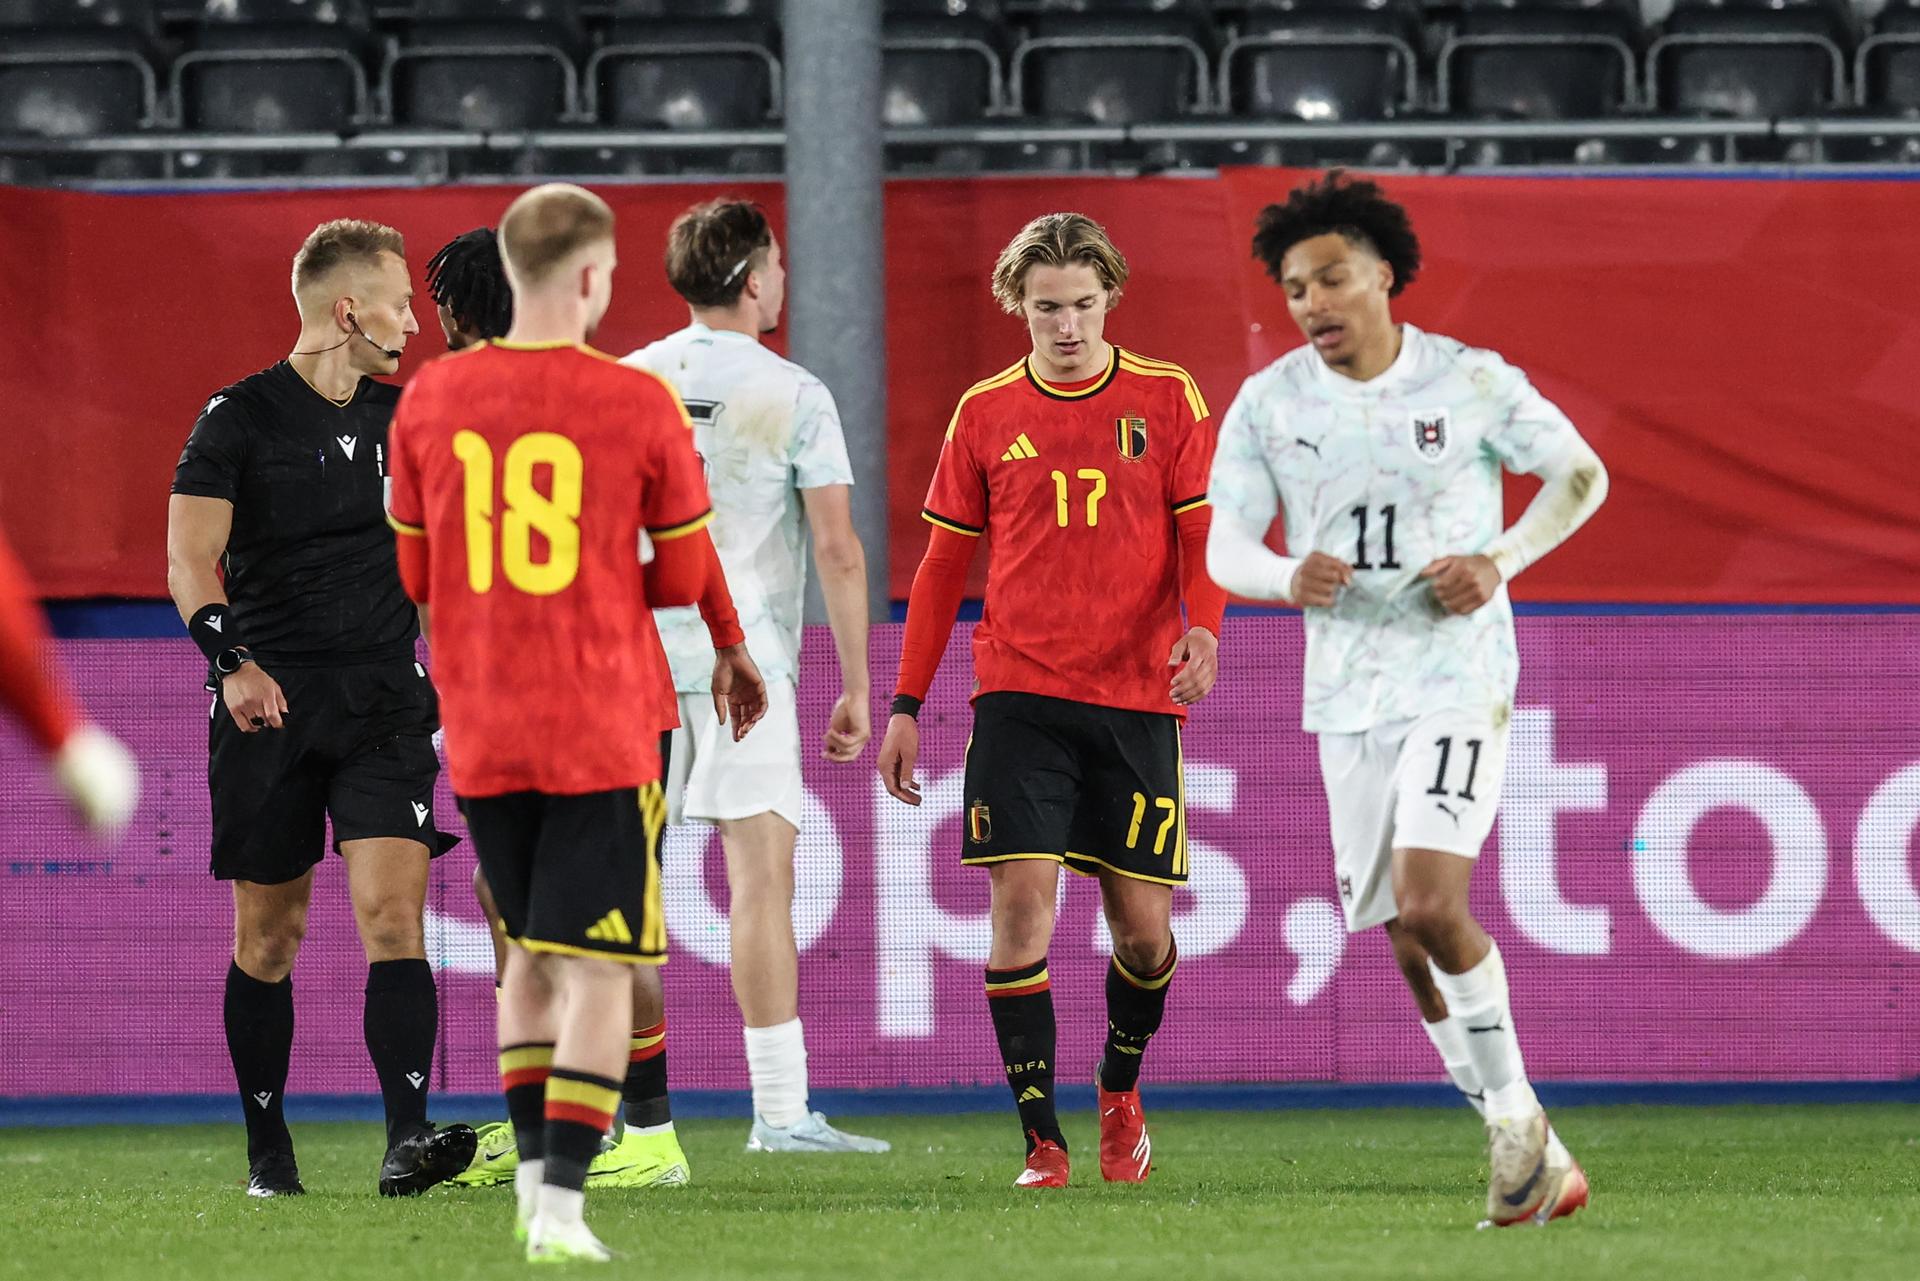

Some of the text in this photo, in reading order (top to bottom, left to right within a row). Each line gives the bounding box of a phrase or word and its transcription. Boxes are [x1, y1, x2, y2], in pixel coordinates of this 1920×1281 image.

[453, 429, 584, 597] 18
[1051, 468, 1107, 527] 17
[1351, 504, 1401, 570] 11
[1426, 736, 1482, 802] 11
[1126, 791, 1176, 855] 17
[1006, 1059, 1047, 1074] RBFA
